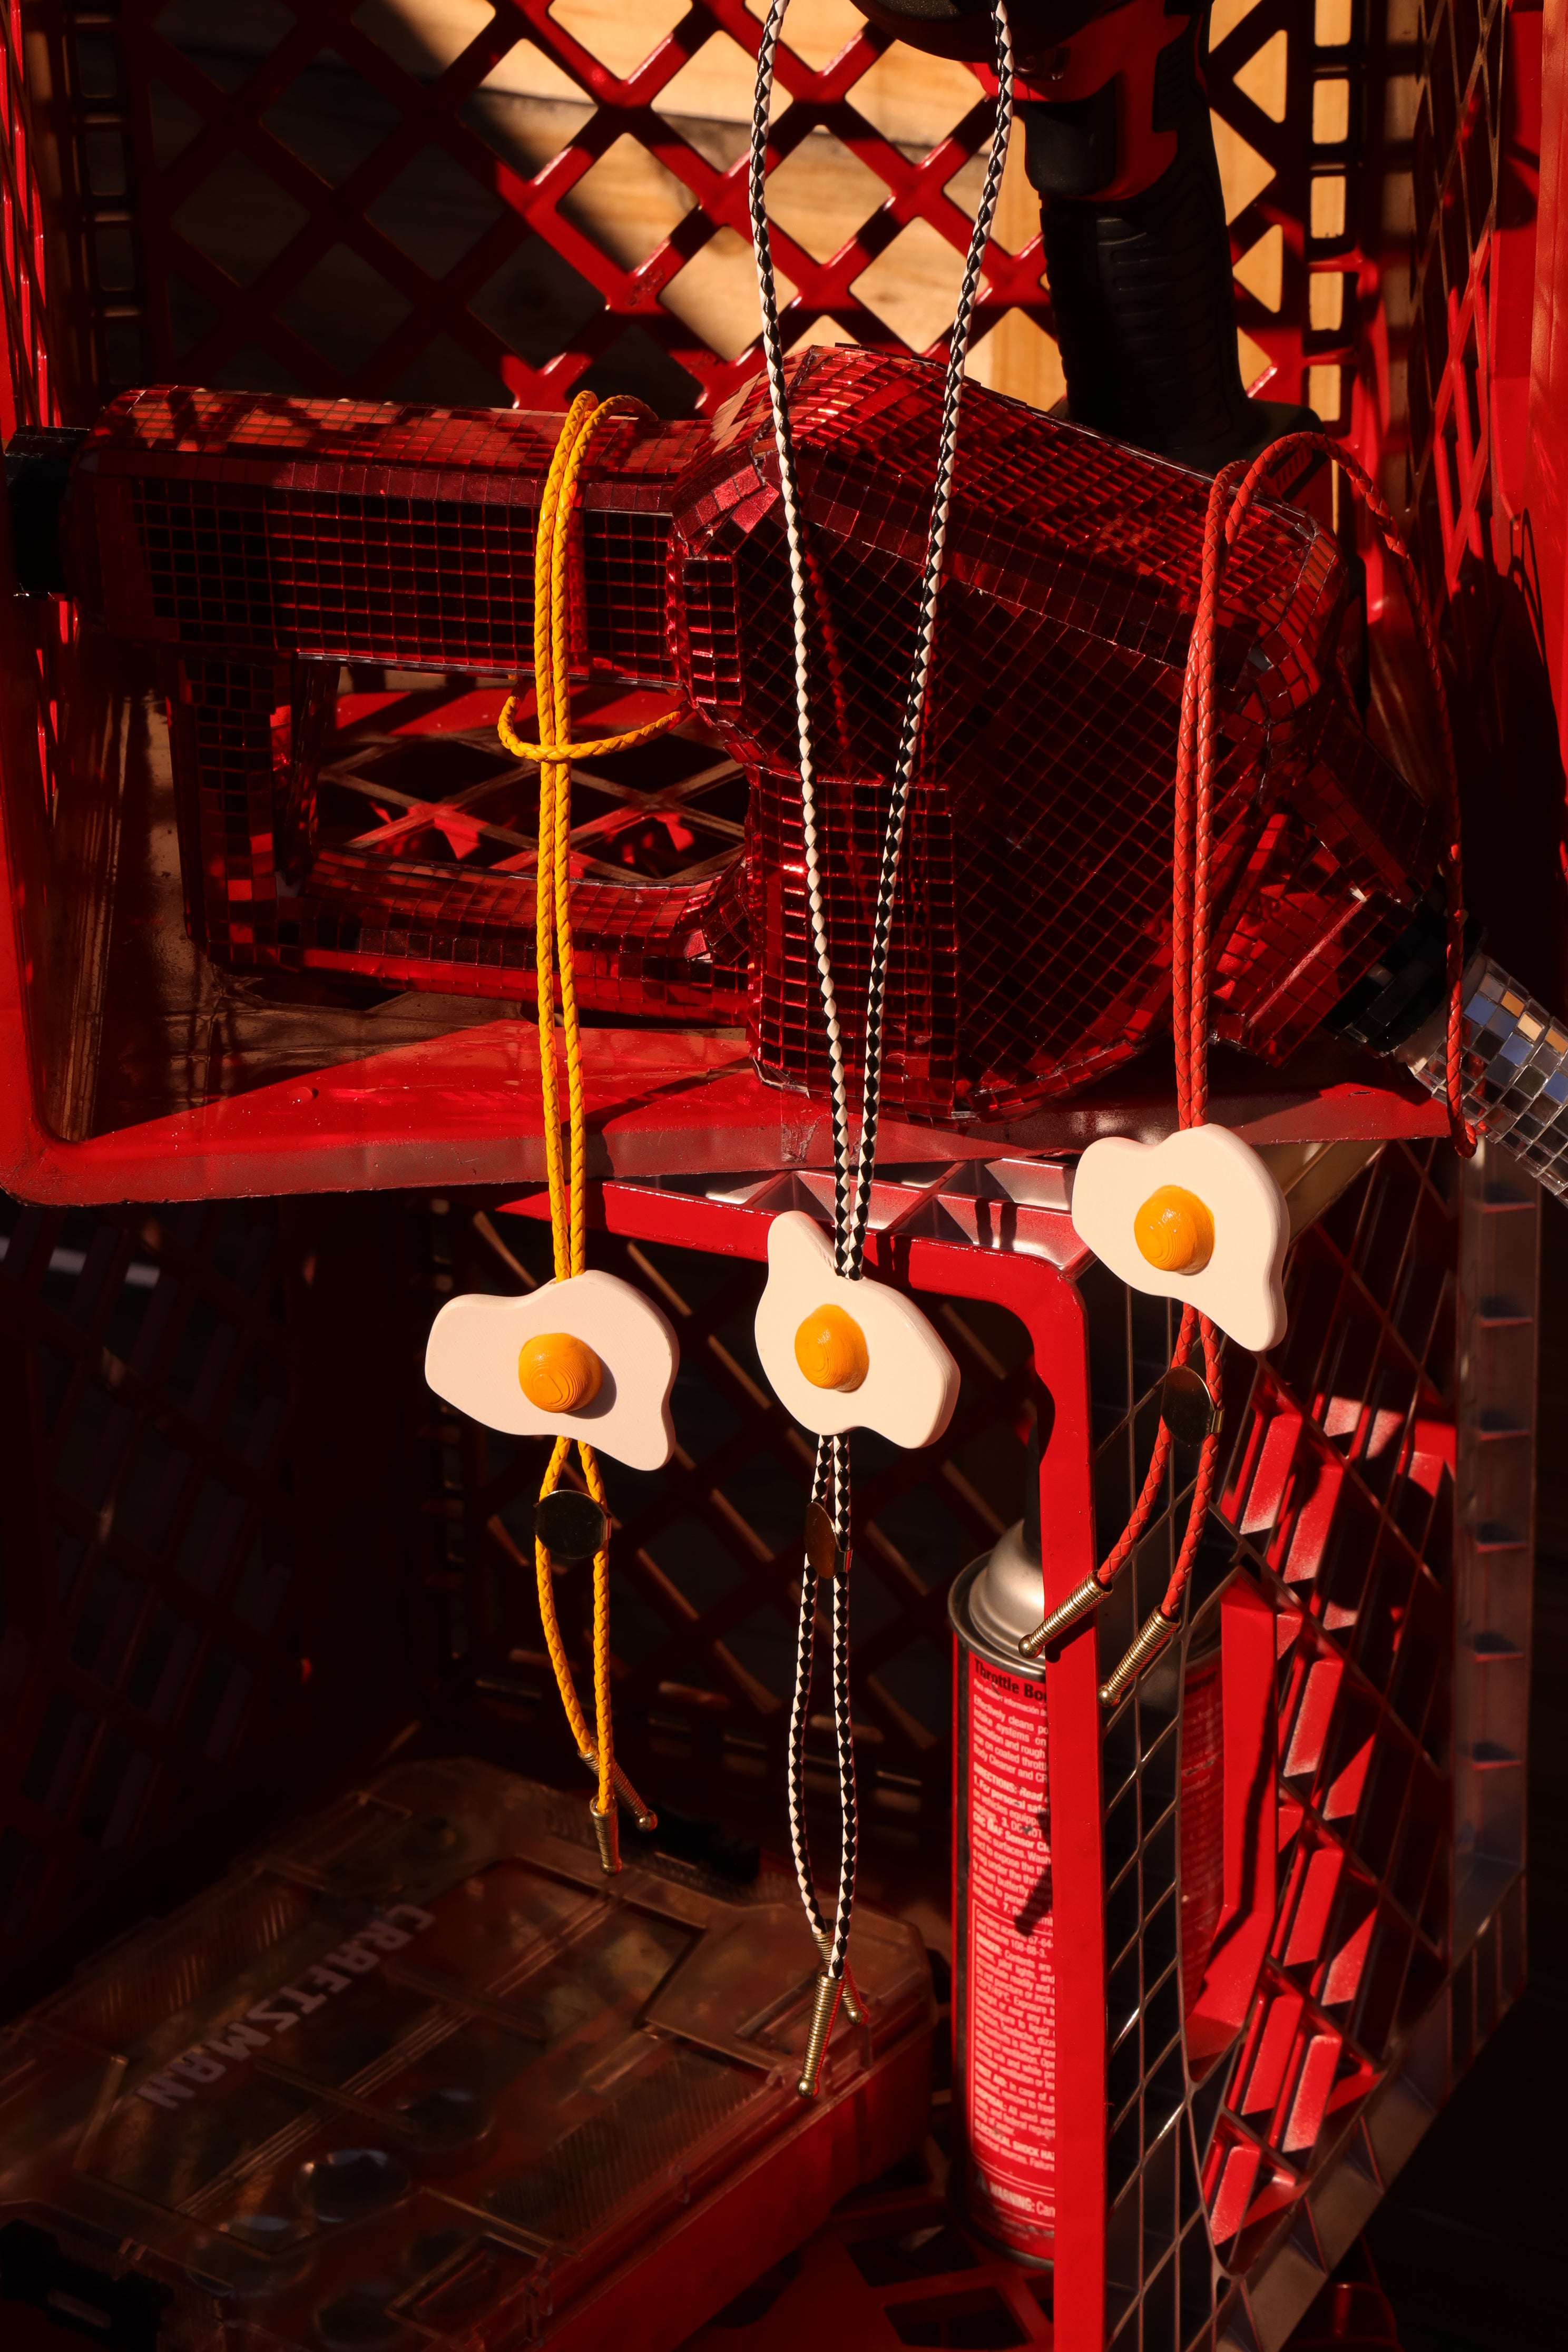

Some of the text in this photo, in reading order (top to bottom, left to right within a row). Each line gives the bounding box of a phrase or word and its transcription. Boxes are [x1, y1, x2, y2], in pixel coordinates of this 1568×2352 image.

[975, 1658, 1019, 1693] Throttle
[974, 1694, 1005, 1722] Effectively
[1008, 1716, 1034, 1732] cleans
[1004, 1696, 1039, 1714] información
[974, 1718, 1045, 1760] hesitation and rough
[995, 1723, 1030, 1742] systems
[974, 1732, 984, 1746] use
[985, 1741, 993, 1752] on
[995, 1747, 1020, 1764] coated
[974, 1742, 988, 1762] Body
[989, 1754, 1016, 1775] Cleaner
[1017, 1768, 1033, 1781] and
[974, 1761, 1043, 1802] DIRECTIONS: Read
[979, 1779, 991, 1794] For
[991, 1788, 1025, 1810] personal
[982, 1794, 1008, 1816] vehicles
[1002, 1816, 1009, 1829] 3.
[993, 1838, 1027, 1859] surfaces.
[1027, 1850, 1051, 1865] Wash
[1005, 1830, 1035, 1850] Sensor
[977, 1851, 988, 1867] rag
[988, 1859, 1007, 1876] under
[1009, 1868, 1022, 1881] the
[986, 1845, 993, 1857] to
[994, 1851, 1020, 1869] expose
[1021, 1861, 1034, 1874] the
[973, 1872, 994, 1894] solvent
[995, 1886, 1003, 1898] to
[979, 1865, 996, 1883] move
[997, 1874, 1029, 1898] butterfly
[976, 1908, 1000, 1931] Contains
[1003, 1902, 1011, 1914] 7.
[976, 1920, 1047, 1958] and toluene 108-88-3.
[1004, 1949, 1035, 1969] Contents
[1038, 1963, 1052, 1973] are
[984, 1971, 994, 1984] not
[994, 1977, 1024, 1997] puncture
[1024, 1991, 1033, 2000] or
[1010, 1974, 1034, 1991] readily
[1035, 1983, 1051, 1994] and
[1015, 1964, 1037, 1981] lights,
[1040, 1974, 1055, 1985] and
[135, 1904, 436, 2109] CRAFTSMAN
[998, 2001, 1007, 2011] or
[1008, 2005, 1025, 2018] near
[1026, 2012, 1041, 2025] any
[1014, 1995, 1047, 2015] Exposure
[1018, 2018, 1026, 2031] to
[1028, 2022, 1050, 2037] liquid
[1002, 2045, 1040, 2065] ventilation.
[1011, 2037, 1019, 2049] is
[1020, 2041, 1042, 2056] illegal
[999, 2065, 1034, 2085] ventilation
[1035, 2078, 1044, 2088] or
[1006, 2058, 1021, 2070] and
[1022, 2063, 1042, 2077] while
[1001, 2090, 1027, 2108] remove
[1028, 2099, 1037, 2109] to
[1018, 2086, 1036, 2099] case
[1038, 2092, 1047, 2102] of
[990, 2108, 1003, 2120] and
[1003, 2112, 1028, 2131] federal
[1008, 2105, 1018, 2116] All
[1020, 2111, 1038, 2123] used
[1040, 2116, 1055, 2128] and
[1012, 2140, 1040, 2158] SHOCK
[989, 2180, 1035, 2213] WARNING:
